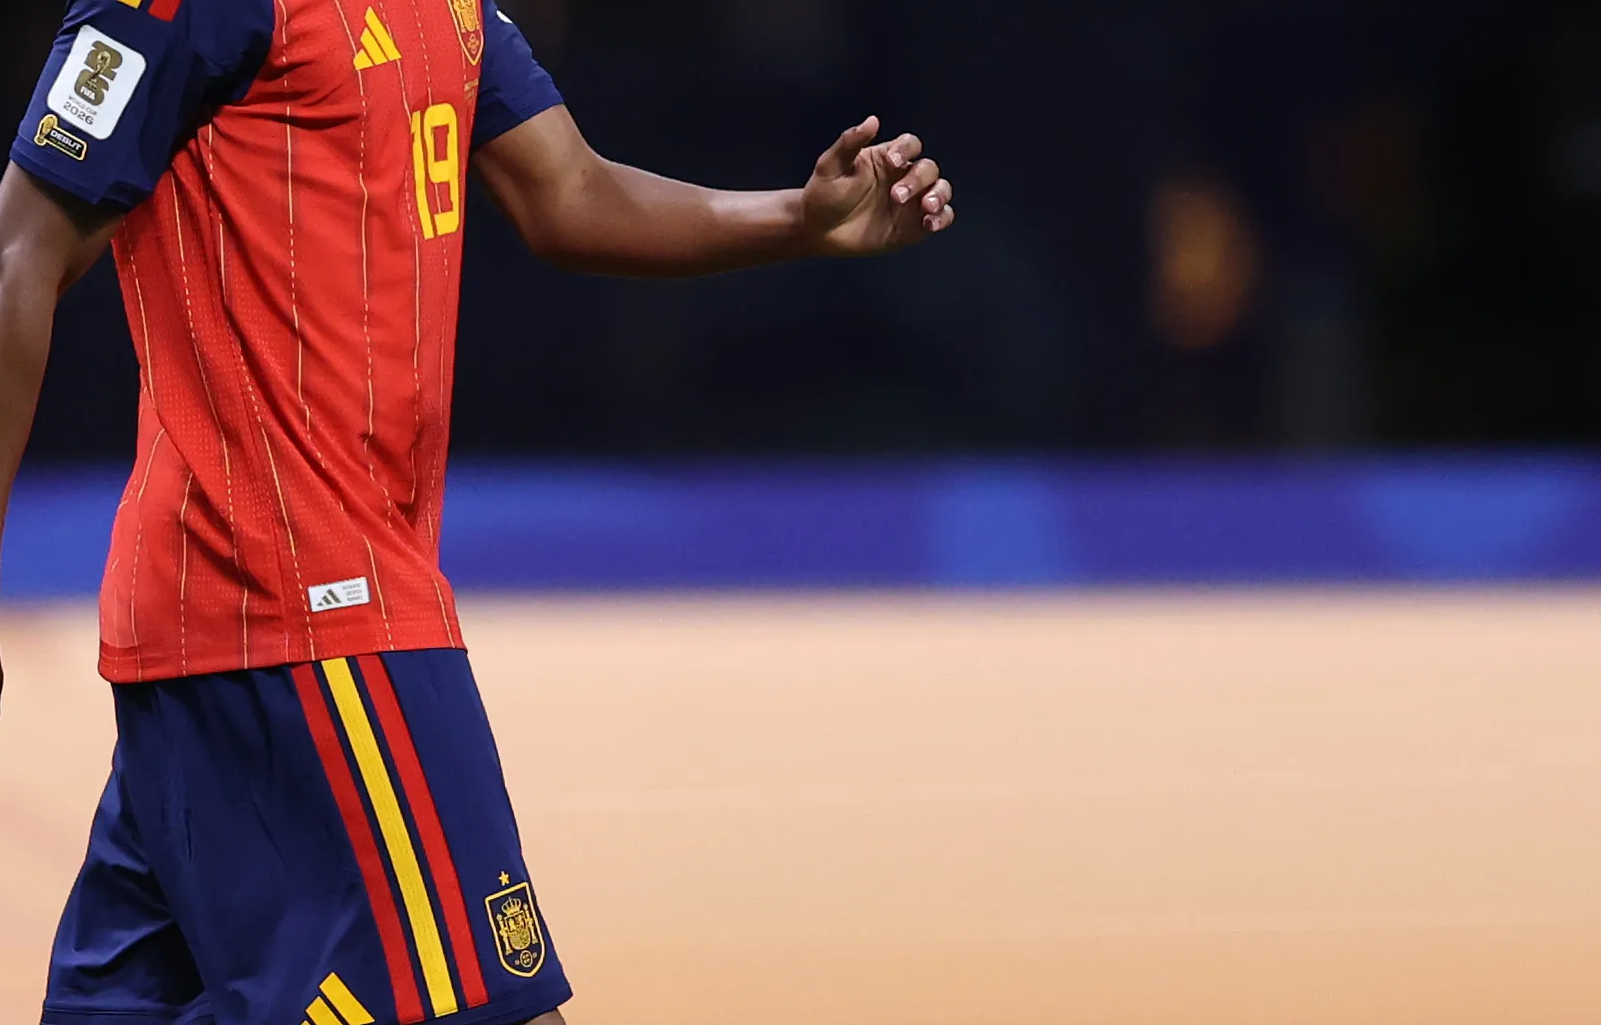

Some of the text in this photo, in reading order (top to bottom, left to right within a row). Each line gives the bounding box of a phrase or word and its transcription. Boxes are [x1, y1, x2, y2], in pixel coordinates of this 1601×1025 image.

[80, 86, 96, 100] FIFA
[63, 101, 94, 126] 2026
[50, 129, 82, 151] DEBUT
[411, 103, 459, 239] 19
